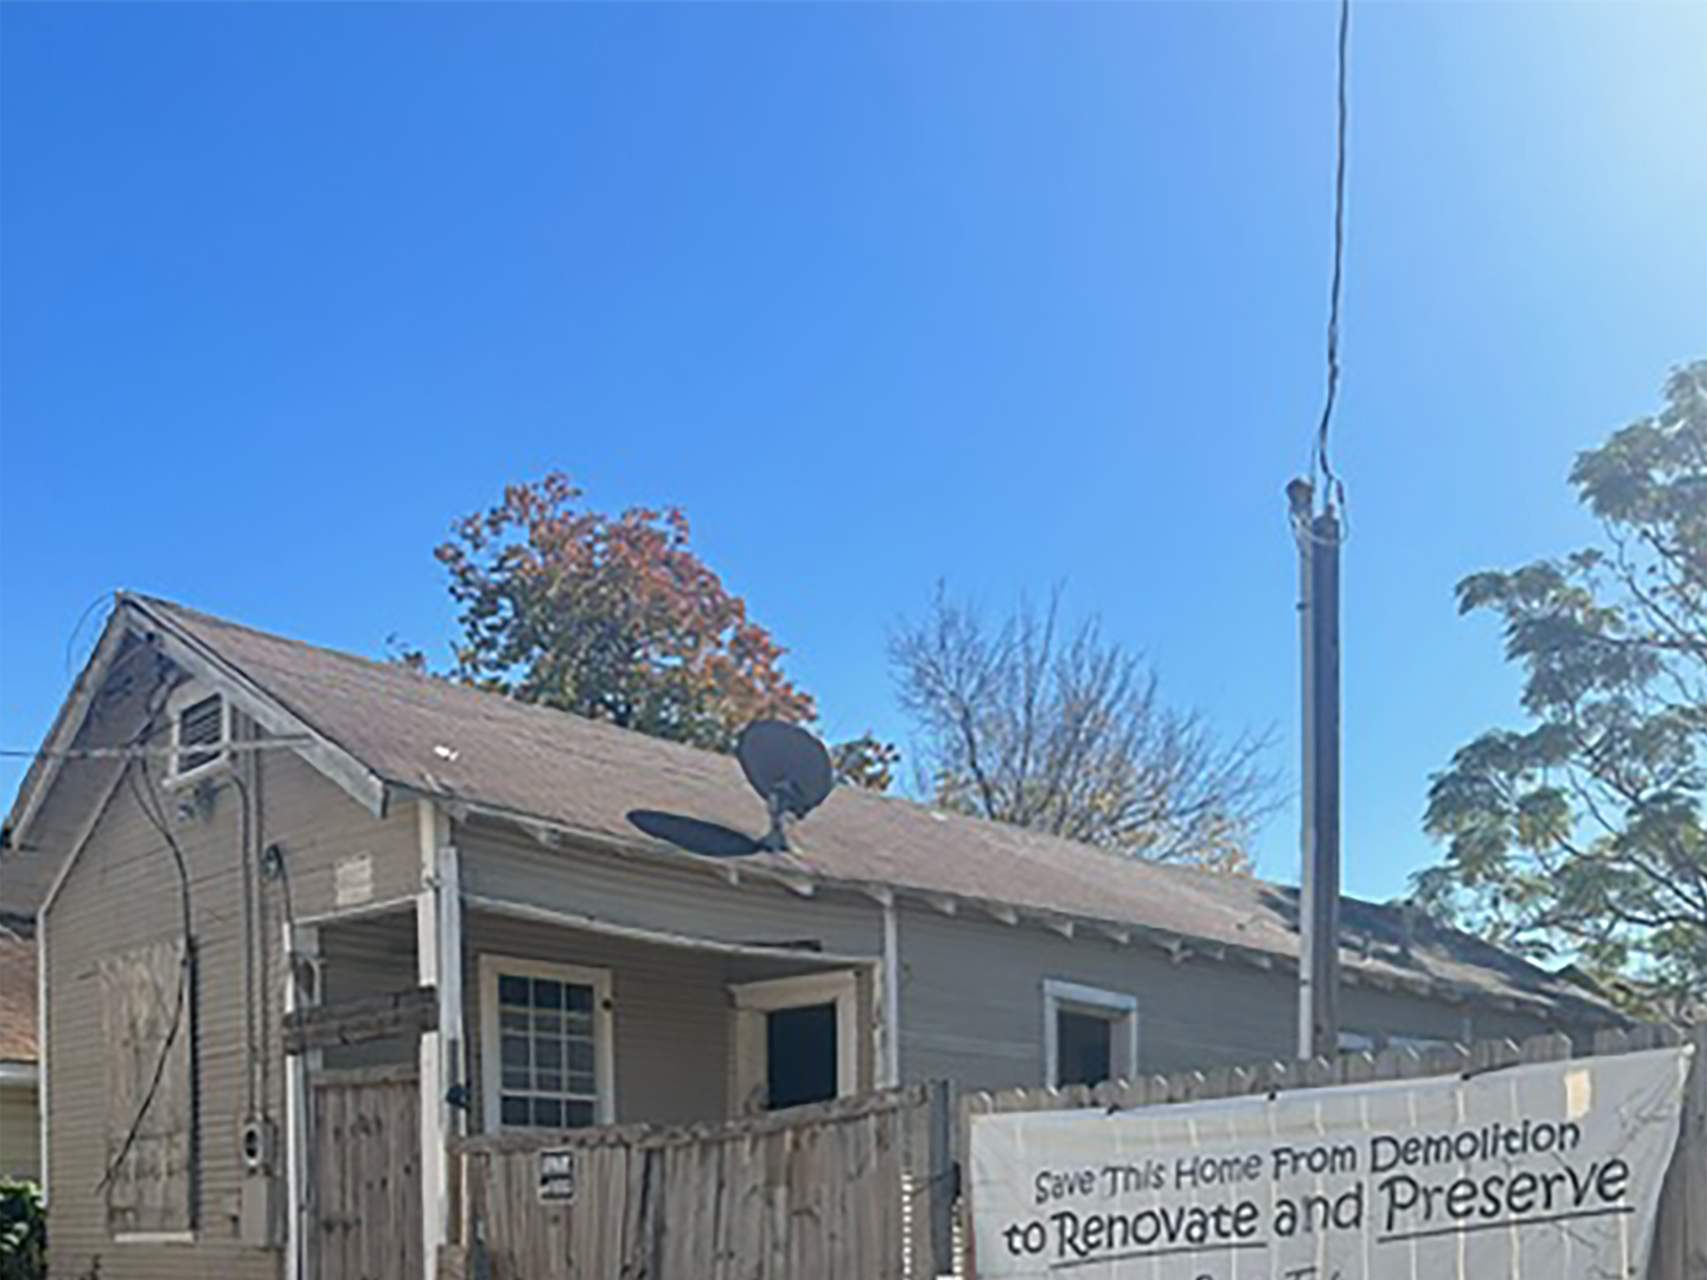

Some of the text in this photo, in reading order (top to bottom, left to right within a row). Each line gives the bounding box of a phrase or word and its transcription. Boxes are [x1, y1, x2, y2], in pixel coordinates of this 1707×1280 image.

[1002, 1157, 1631, 1258] to Renovate and Preserve
[1035, 1119, 1581, 1204] Save This Home From Demolition
